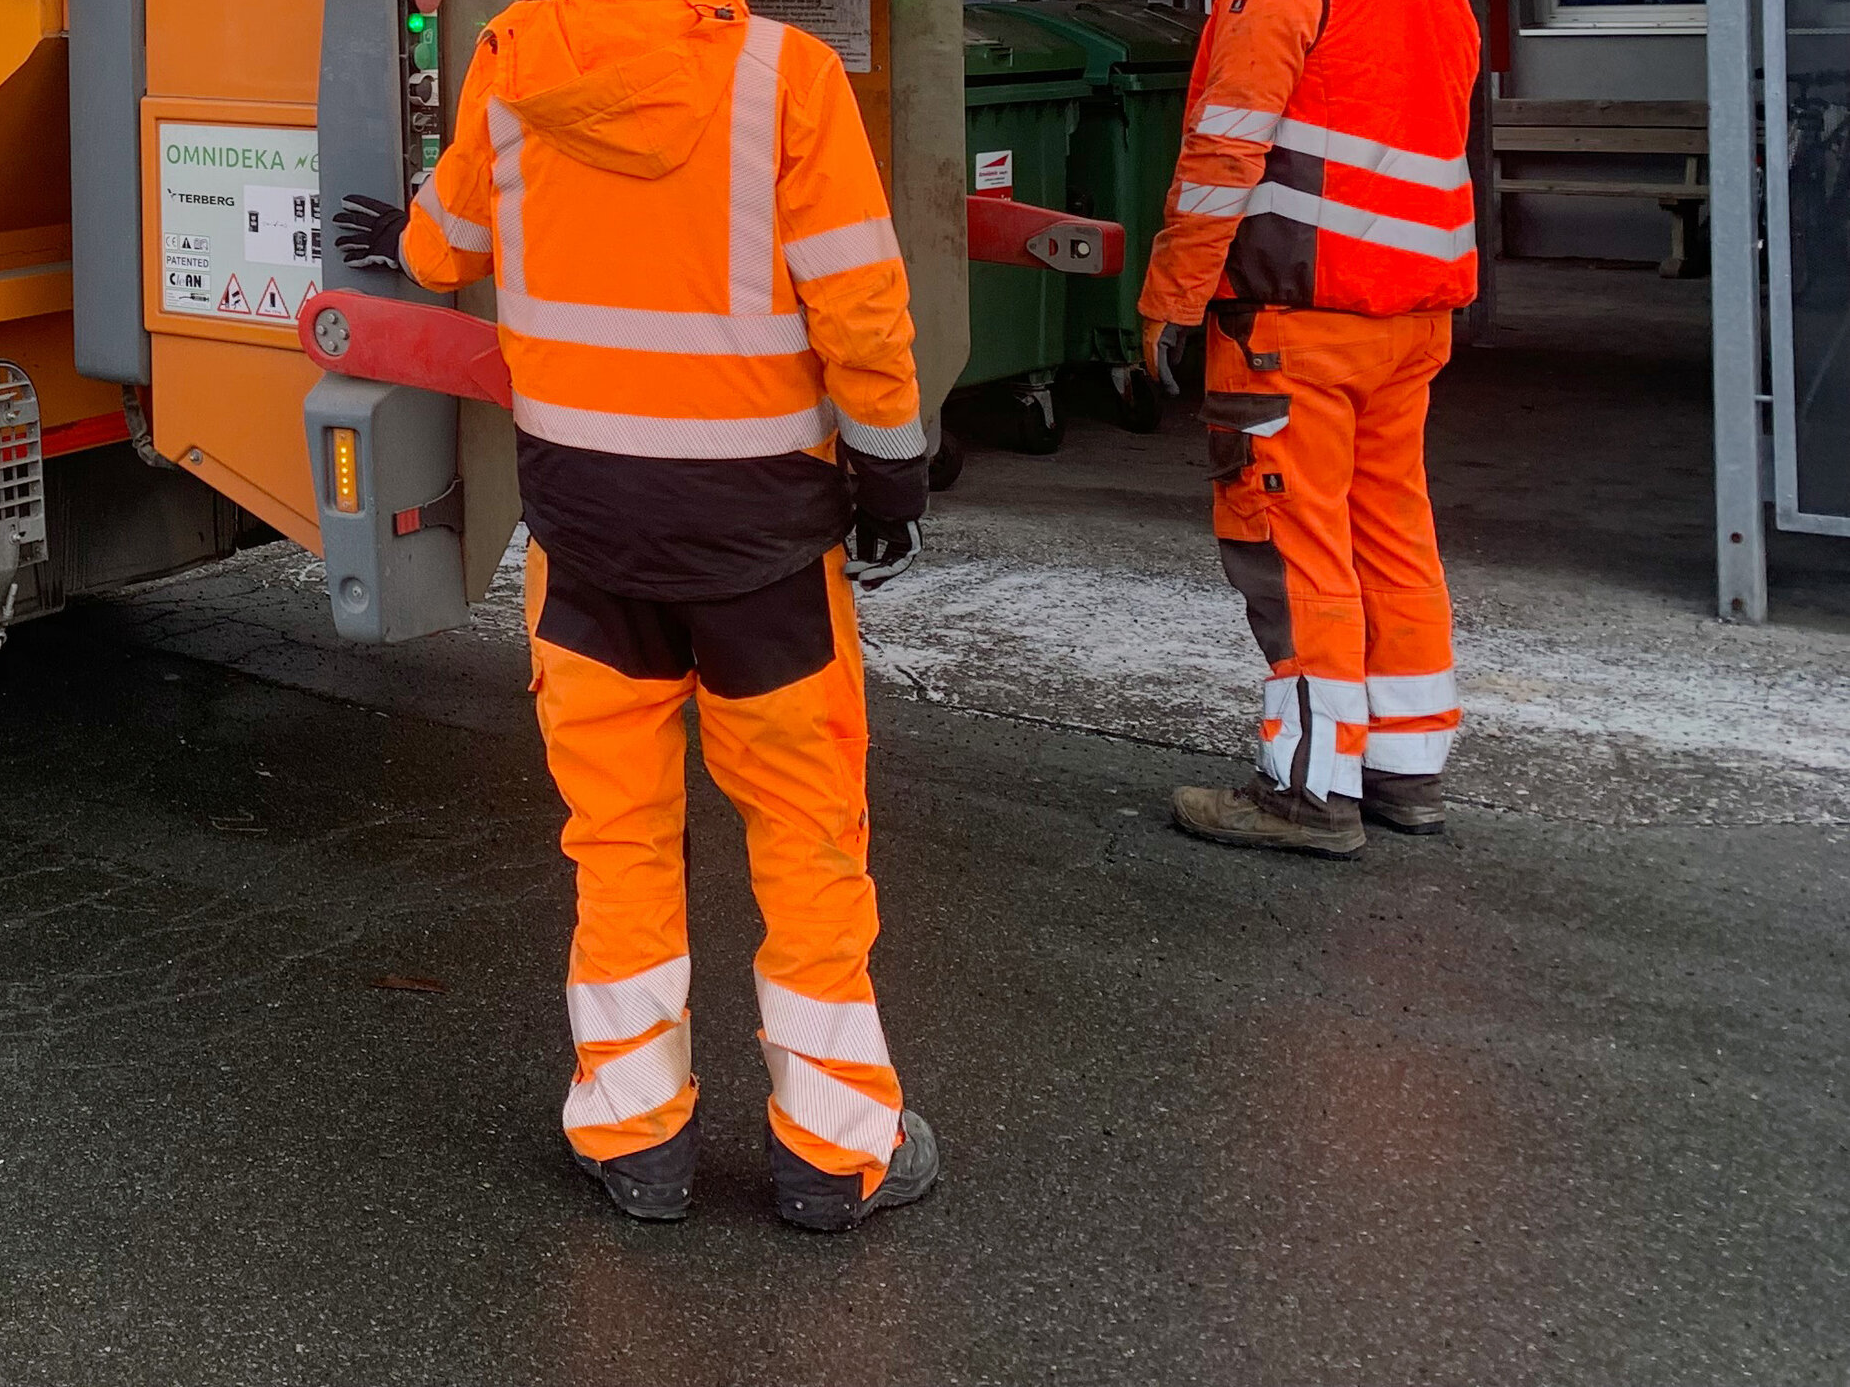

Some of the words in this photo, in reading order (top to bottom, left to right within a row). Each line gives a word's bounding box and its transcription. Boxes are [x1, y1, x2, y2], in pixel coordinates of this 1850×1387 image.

[166, 144, 285, 171] OMNIDEKA
[178, 193, 235, 207] TERBERG
[166, 255, 209, 268] PATENTED
